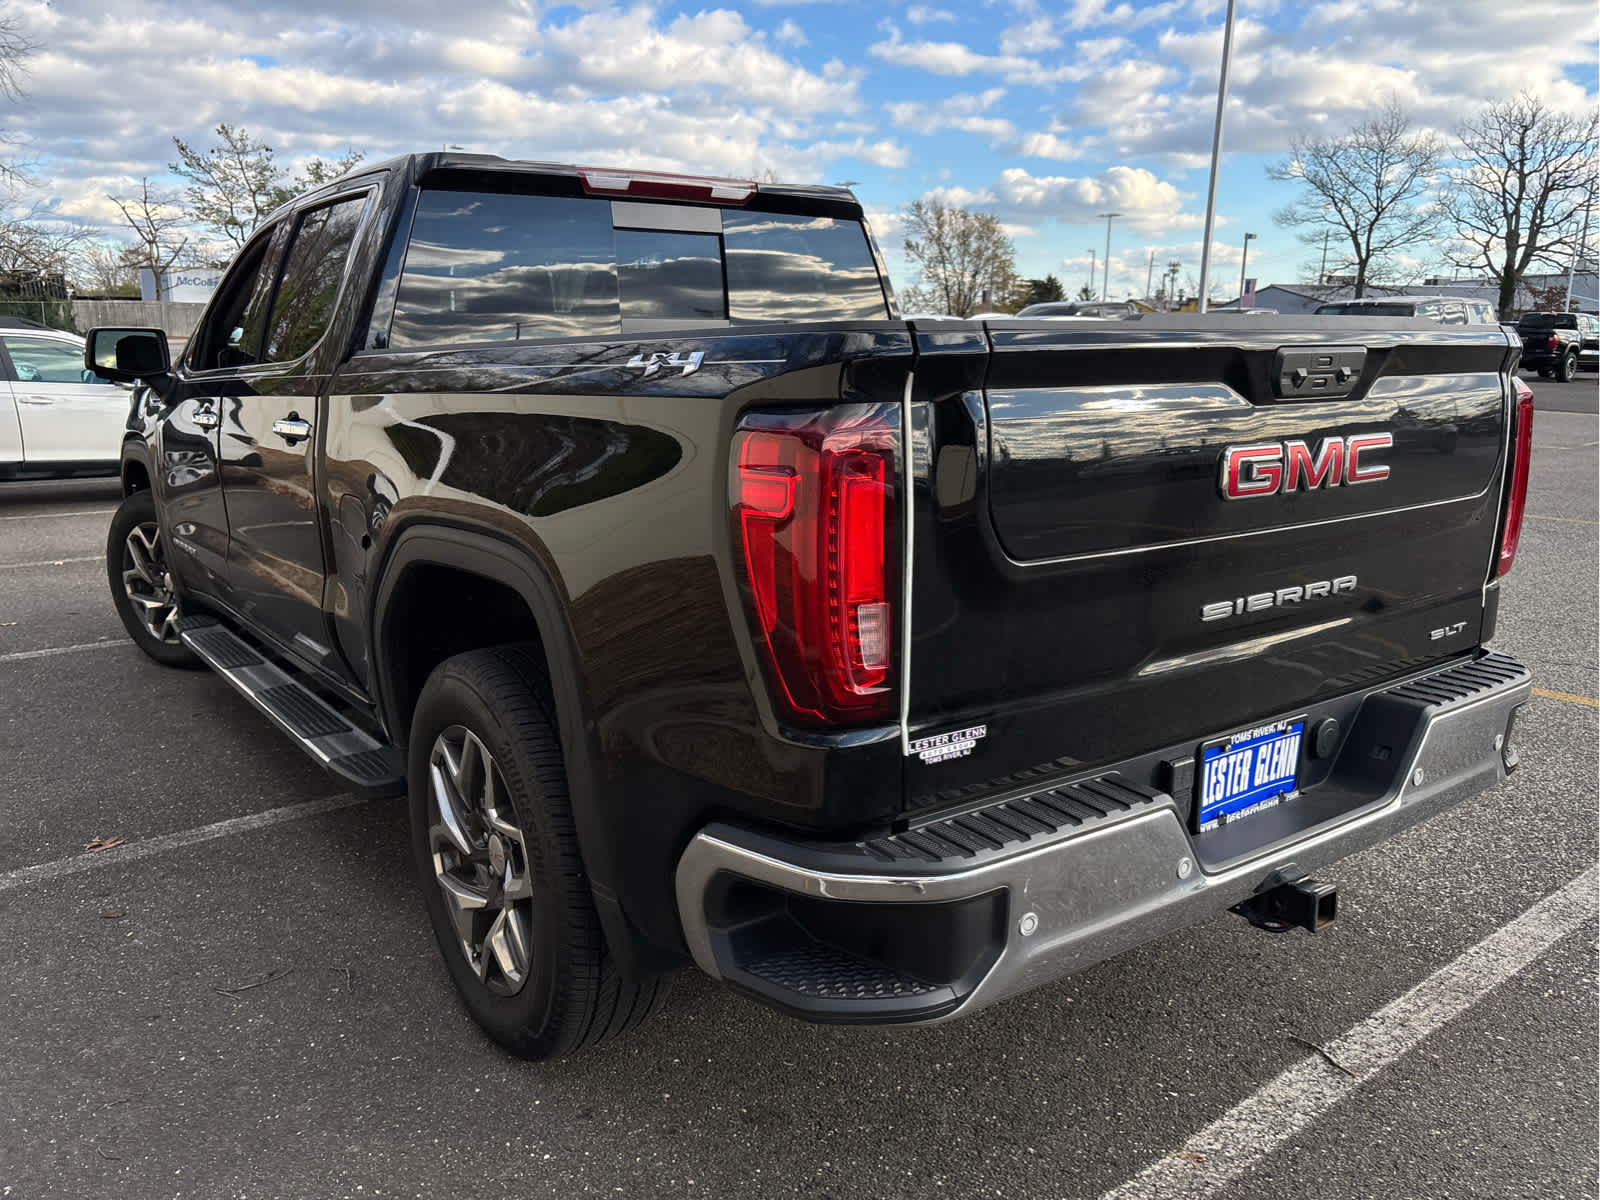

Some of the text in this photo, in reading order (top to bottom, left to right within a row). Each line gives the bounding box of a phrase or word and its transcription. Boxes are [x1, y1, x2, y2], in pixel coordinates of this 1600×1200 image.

[1220, 432, 1393, 500] GMC
[1200, 575, 1358, 622] SIERRA
[1429, 621, 1468, 641] SLT
[909, 728, 986, 752] LESTER GLENN
[1202, 734, 1301, 808] LESTER GLENN
